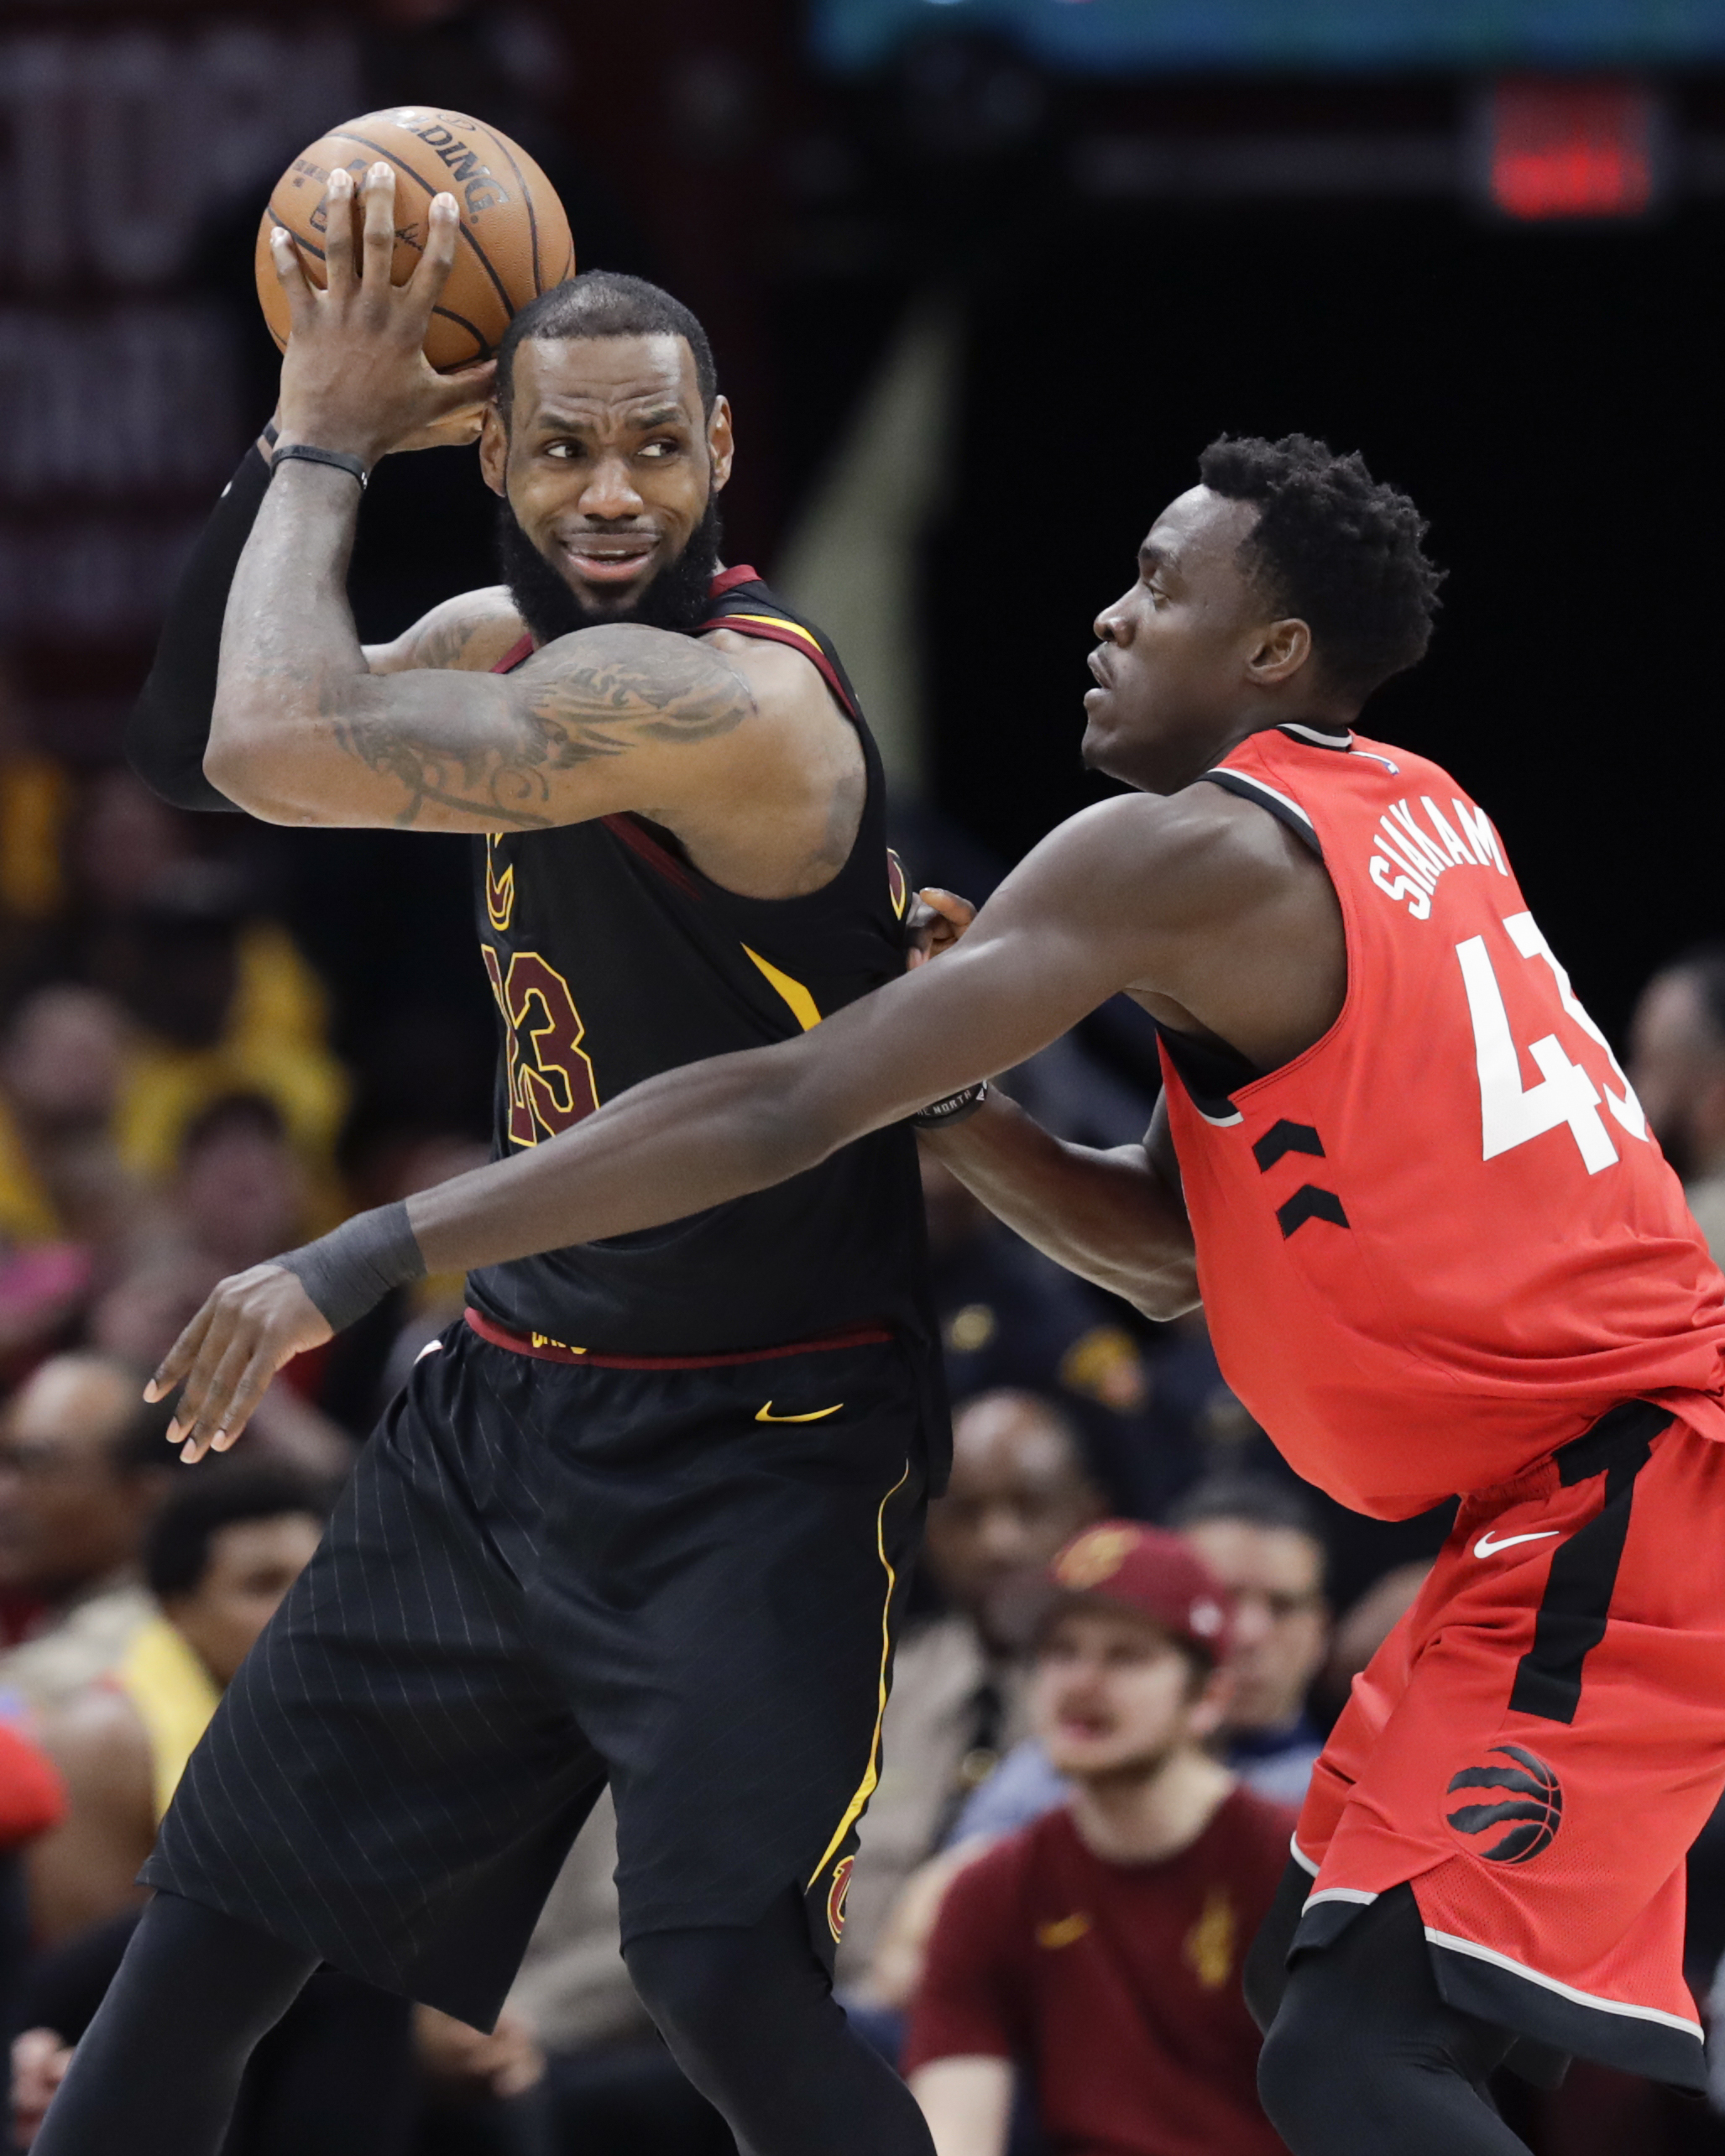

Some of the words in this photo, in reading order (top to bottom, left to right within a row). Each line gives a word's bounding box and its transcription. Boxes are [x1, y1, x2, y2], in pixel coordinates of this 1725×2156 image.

[365, 110, 510, 214] LDING
[1369, 795, 1508, 921] SIAKAM
[1455, 910, 1649, 1175] 43
[932, 1089, 973, 1115] NORTH
